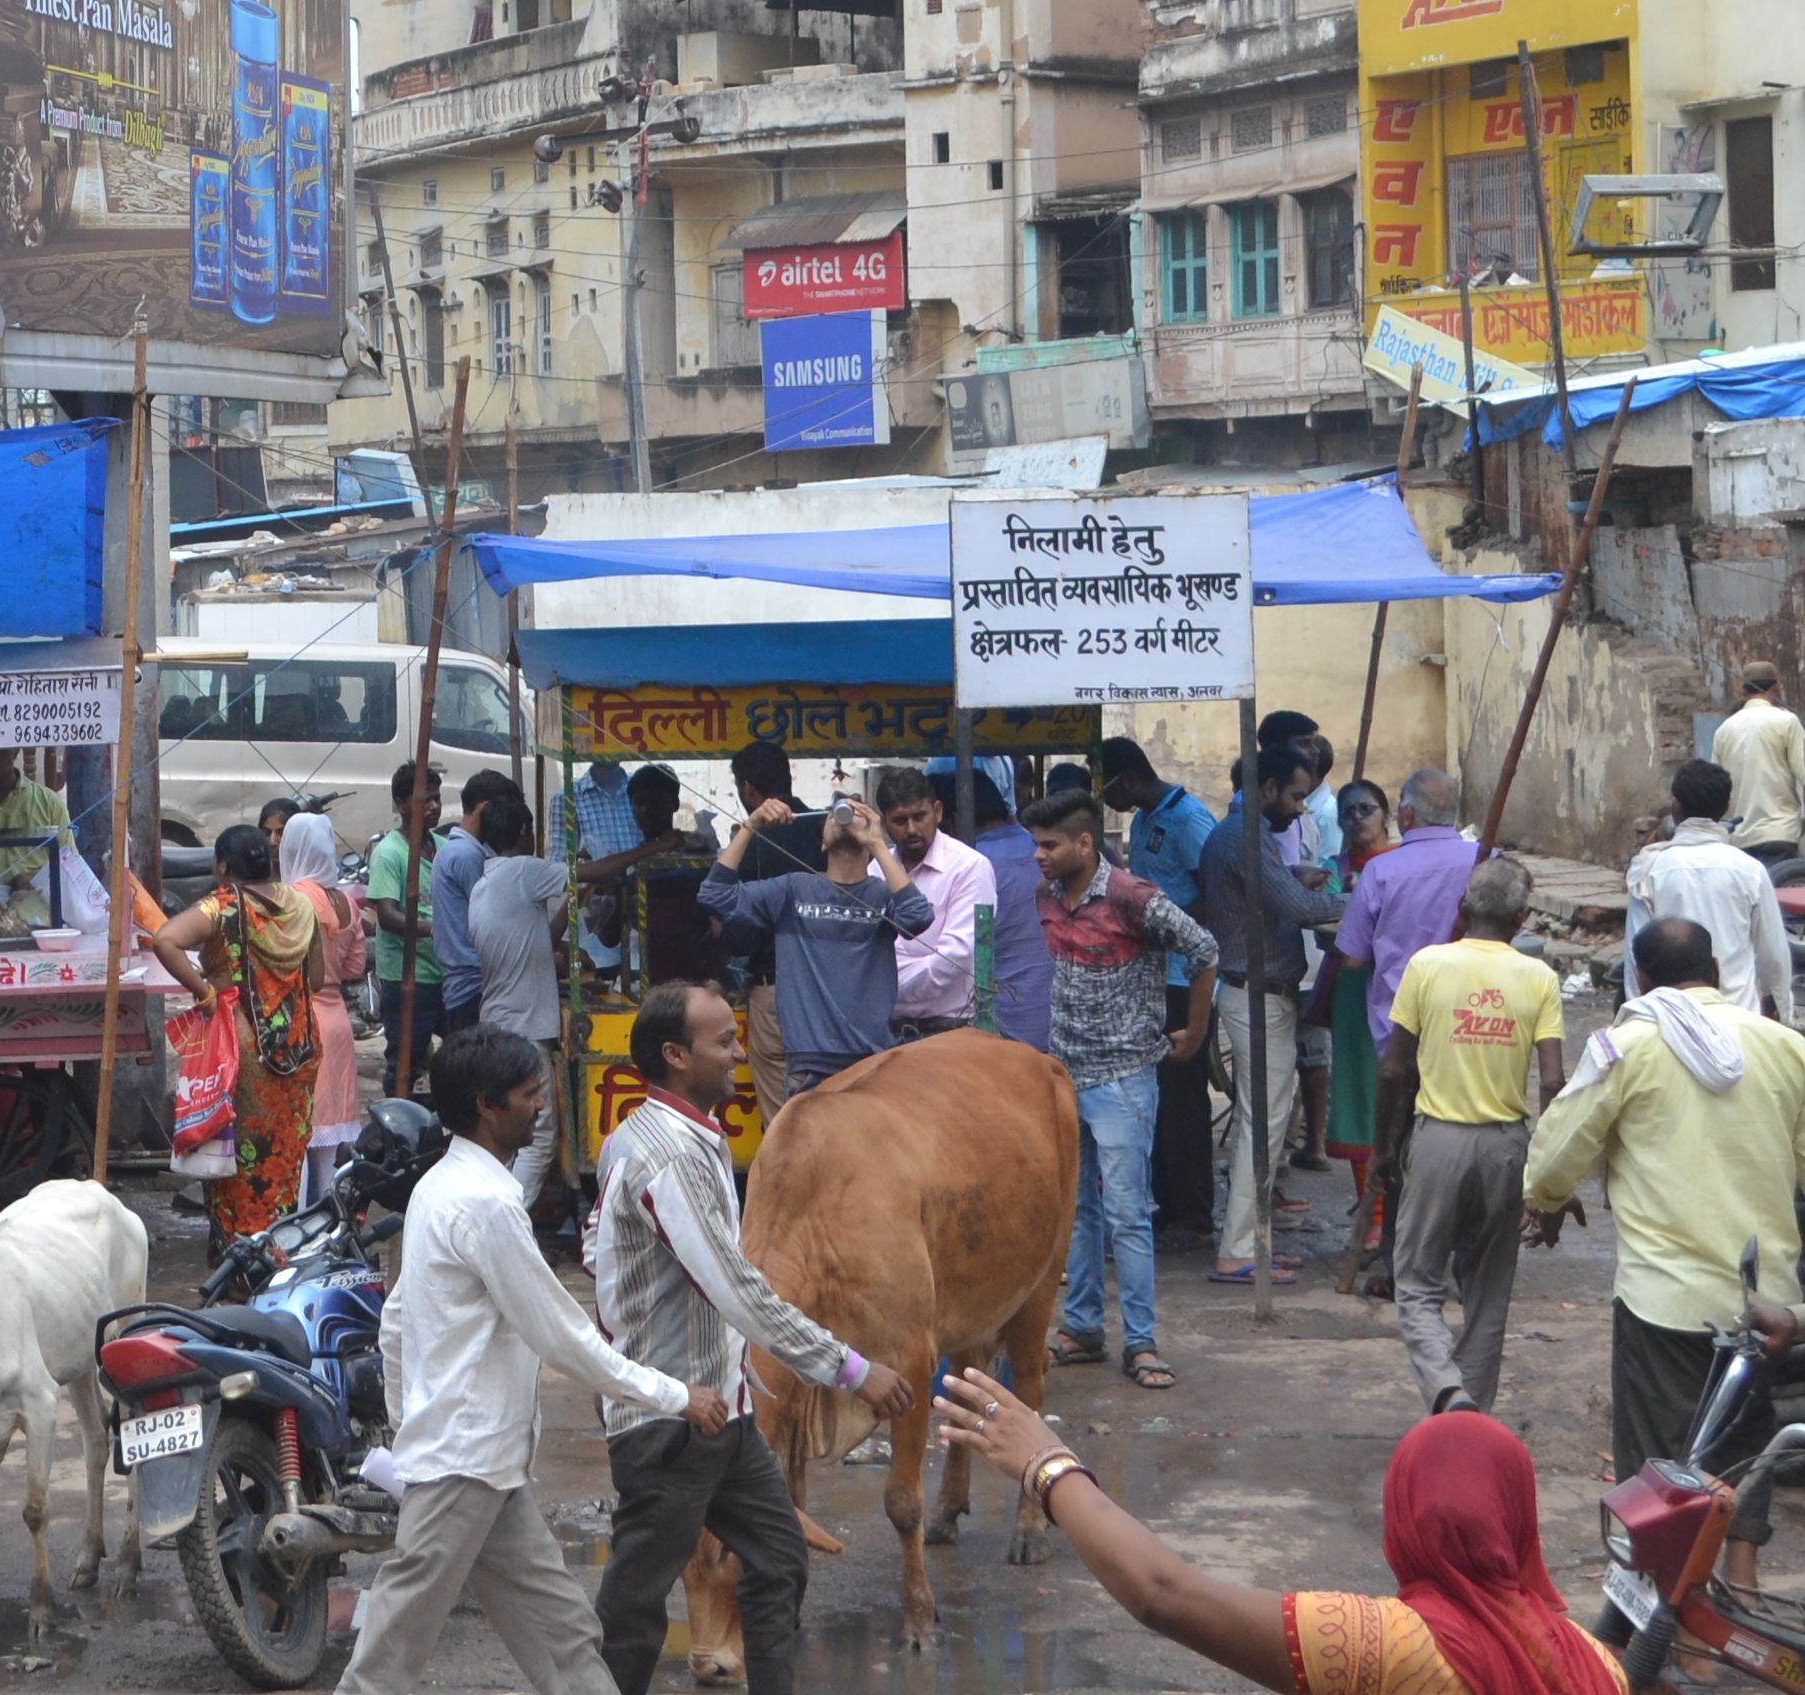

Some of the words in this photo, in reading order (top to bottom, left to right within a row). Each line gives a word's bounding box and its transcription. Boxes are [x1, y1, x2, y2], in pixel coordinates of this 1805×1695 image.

[80, 0, 113, 32] Pan
[117, 0, 174, 48] Masala
[781, 255, 843, 287] airtel
[852, 252, 886, 281] 4G
[1374, 319, 1458, 385] Rajasthan
[774, 354, 862, 388] SAMSUNG
[826, 426, 873, 440] Communication
[1003, 513, 1107, 560] निलामी
[1107, 515, 1165, 565] हेतु
[959, 566, 1059, 612] प्रस्तावित
[1061, 565, 1173, 607] व्यवसायिक
[1175, 573, 1242, 611] भूखण्ड
[1077, 628, 1127, 654] 253
[1134, 617, 1167, 653] वर्ग
[1171, 619, 1223, 655] मीटर
[1074, 687, 1105, 700] नगर
[1108, 683, 1149, 699] विकास
[1187, 686, 1223, 699] अलवर
[13, 701, 102, 722] 8290005192
[587, 686, 731, 751] दिल्ली
[746, 686, 850, 744] छोले
[14, 723, 103, 743] 9694339602
[1452, 1009, 1516, 1038] AVON
[135, 1411, 186, 1437] RJ-02
[126, 1431, 199, 1463] SU-4827
